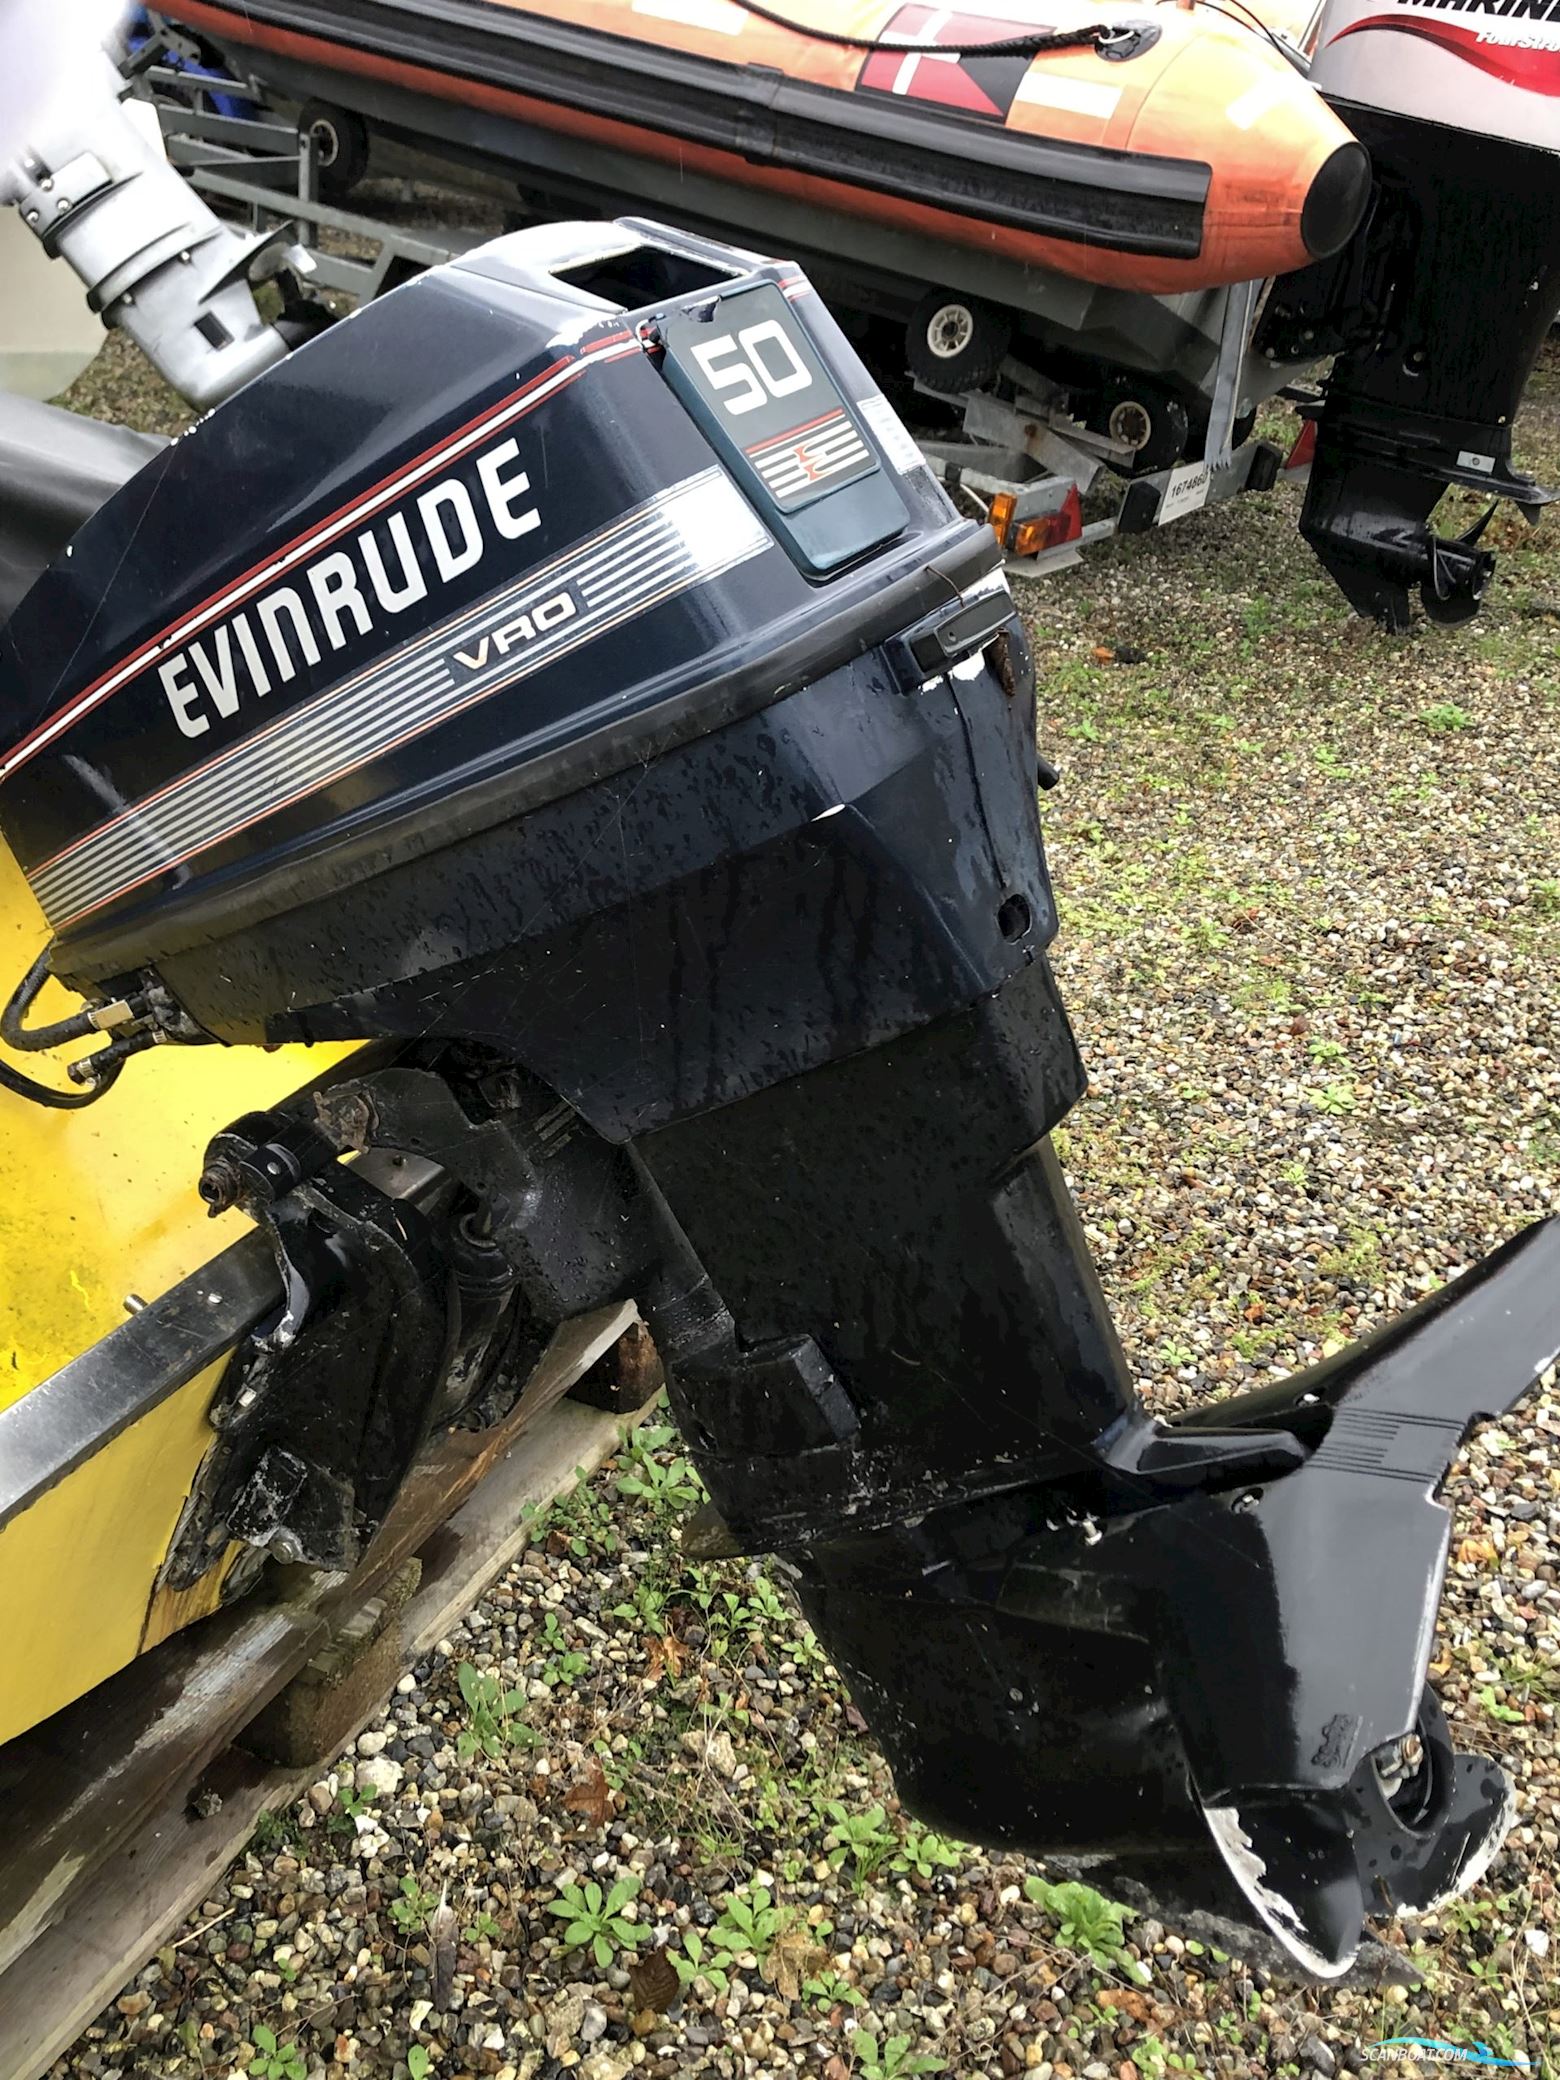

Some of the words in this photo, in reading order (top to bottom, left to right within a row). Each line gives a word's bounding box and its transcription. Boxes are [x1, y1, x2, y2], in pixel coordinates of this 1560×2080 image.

[690, 319, 813, 416] 50
[157, 437, 541, 738] EVINRUDE
[452, 591, 577, 670] VRO
